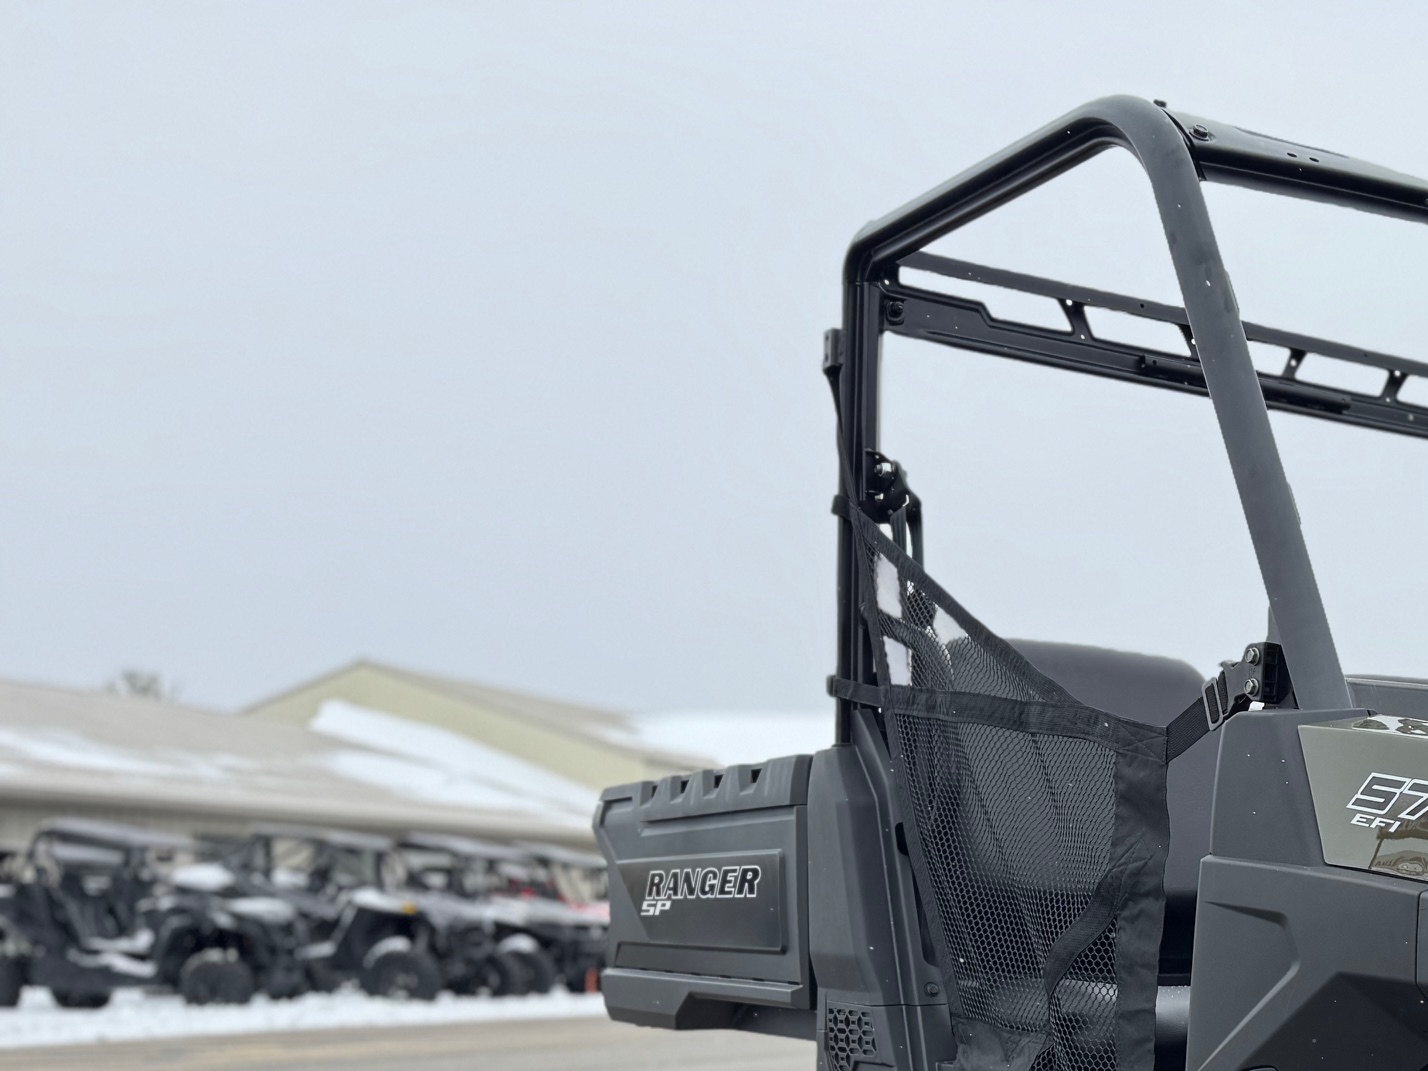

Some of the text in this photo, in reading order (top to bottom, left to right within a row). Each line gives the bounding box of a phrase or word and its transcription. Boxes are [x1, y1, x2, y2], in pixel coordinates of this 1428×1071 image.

[1350, 813, 1401, 832] EFI
[645, 865, 761, 900] RANGER
[640, 900, 672, 916] SP
